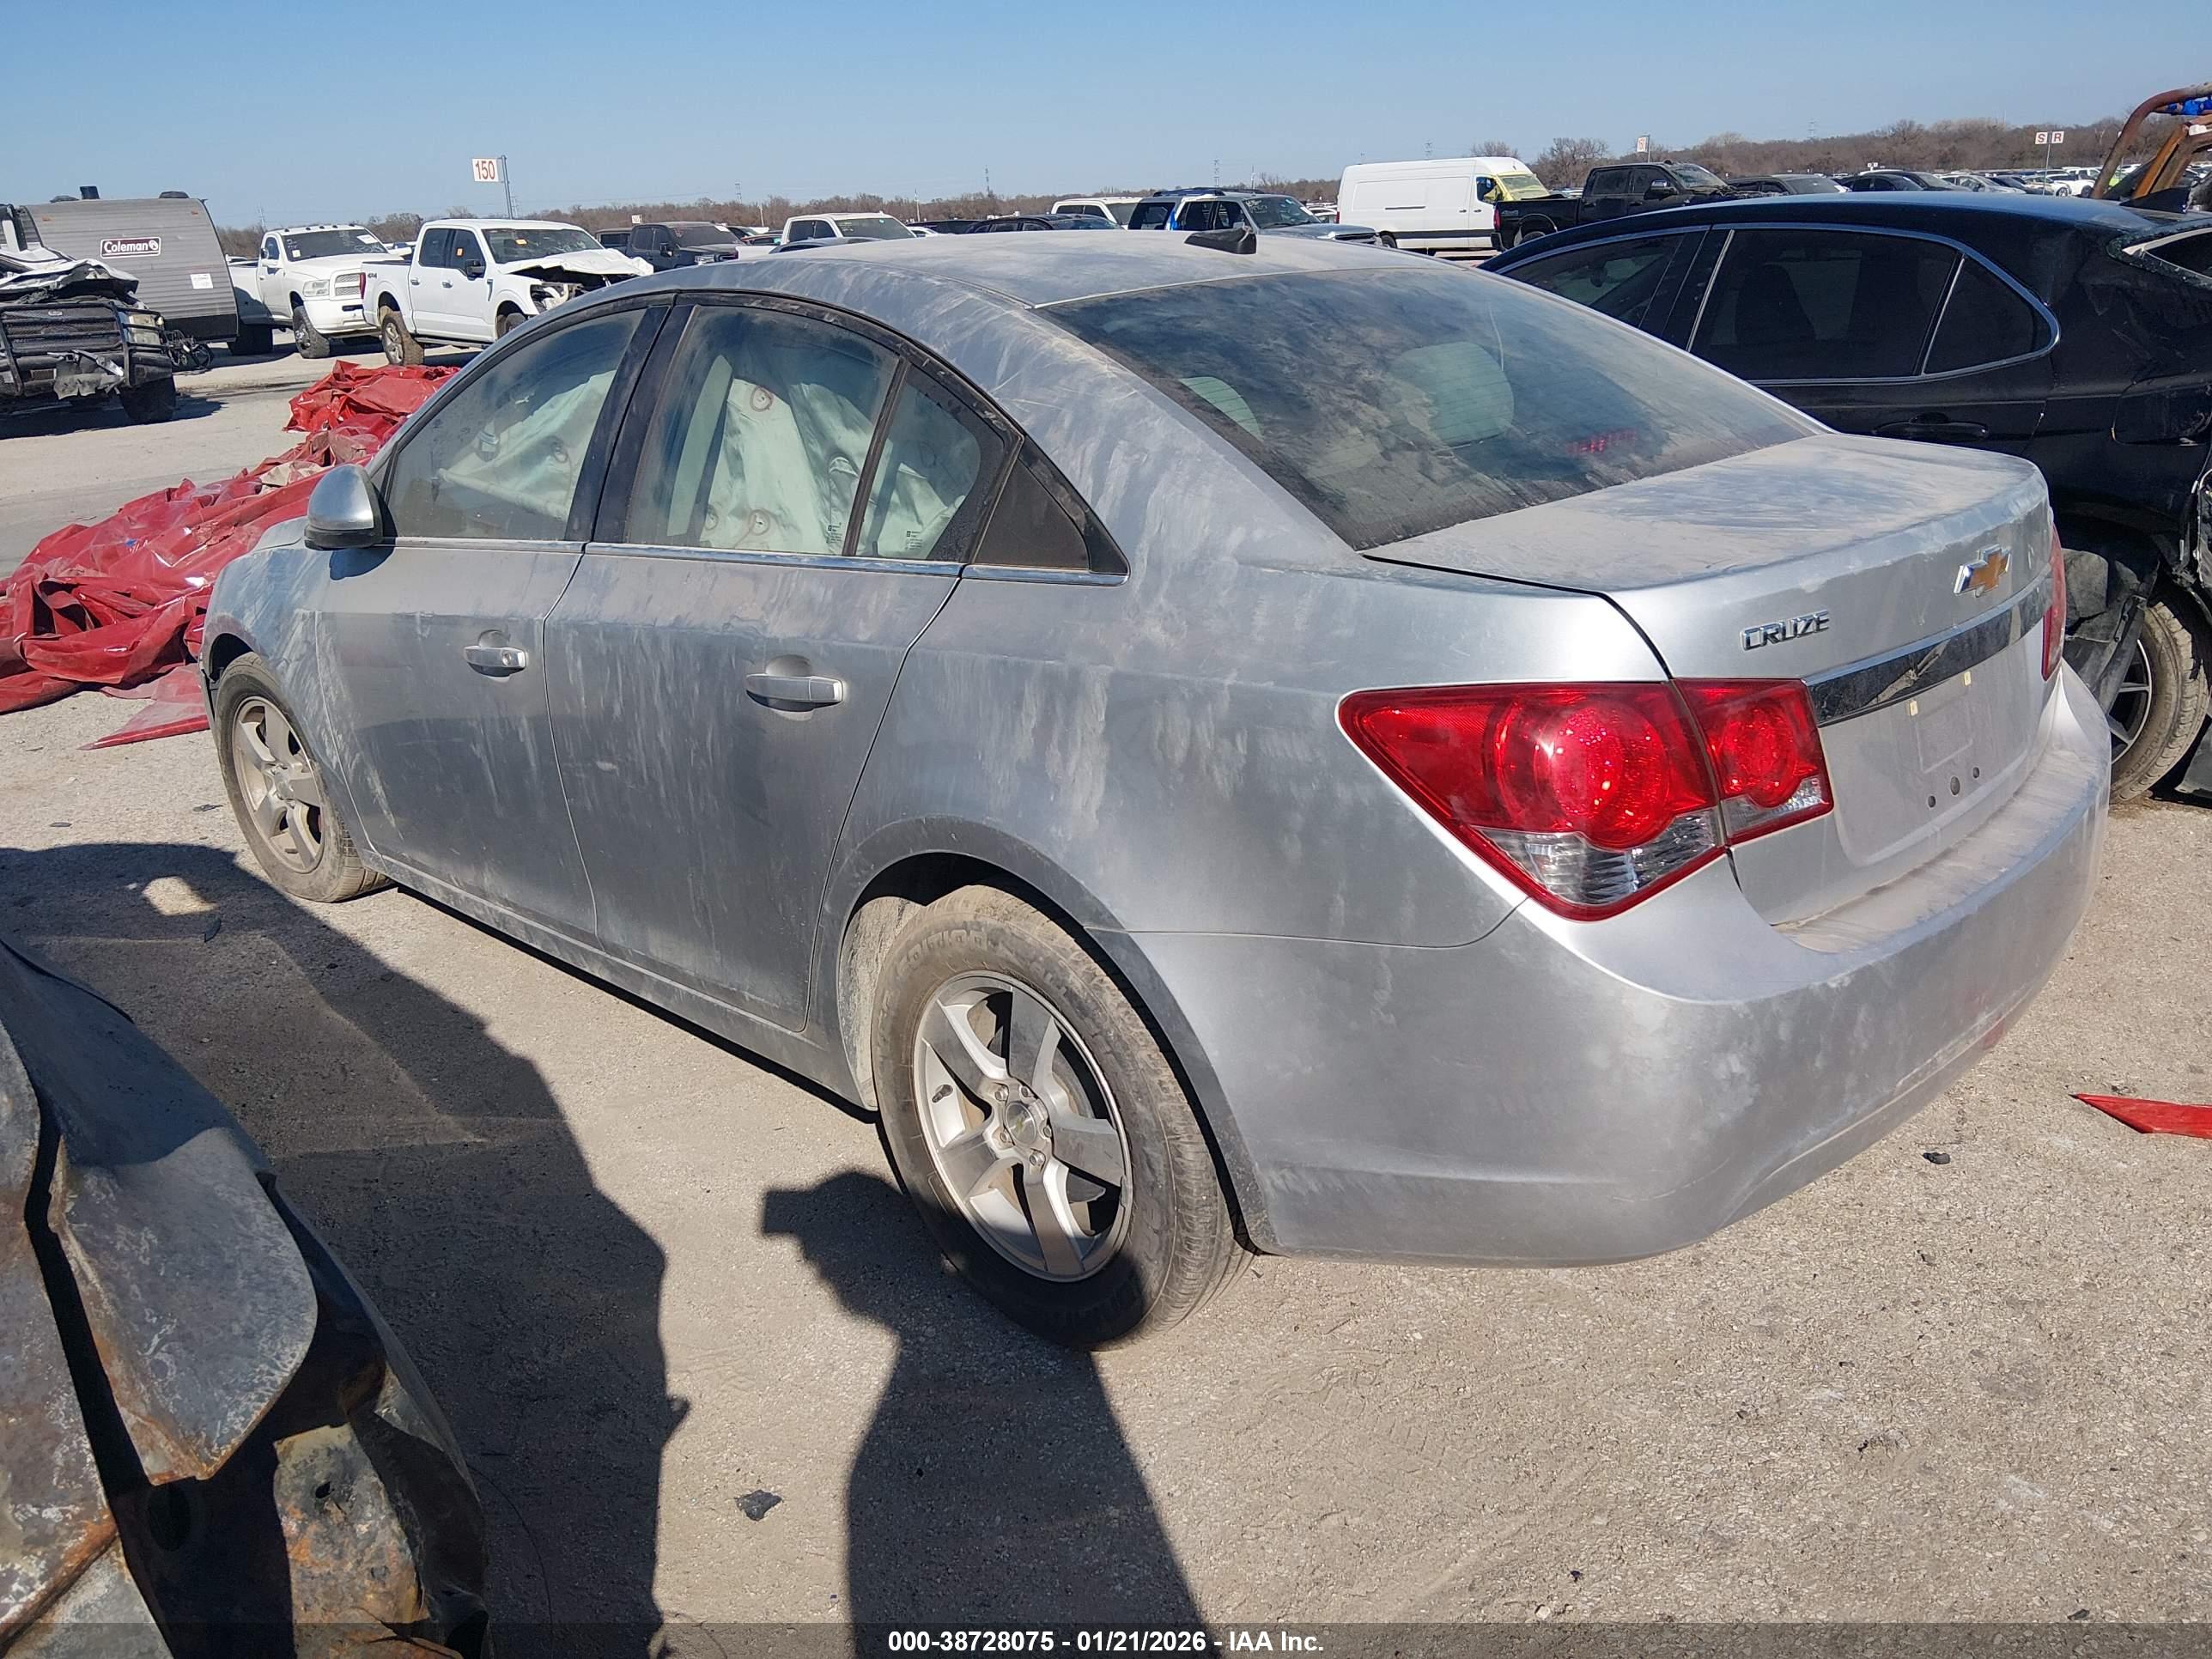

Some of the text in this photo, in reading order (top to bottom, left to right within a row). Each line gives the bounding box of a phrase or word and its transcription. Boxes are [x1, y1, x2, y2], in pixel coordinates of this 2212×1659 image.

[2037, 133, 2046, 143] S
[2053, 132, 2062, 143] R
[475, 160, 495, 179] 150
[103, 240, 149, 253] Coleman
[1740, 610, 1830, 651] CRUZE
